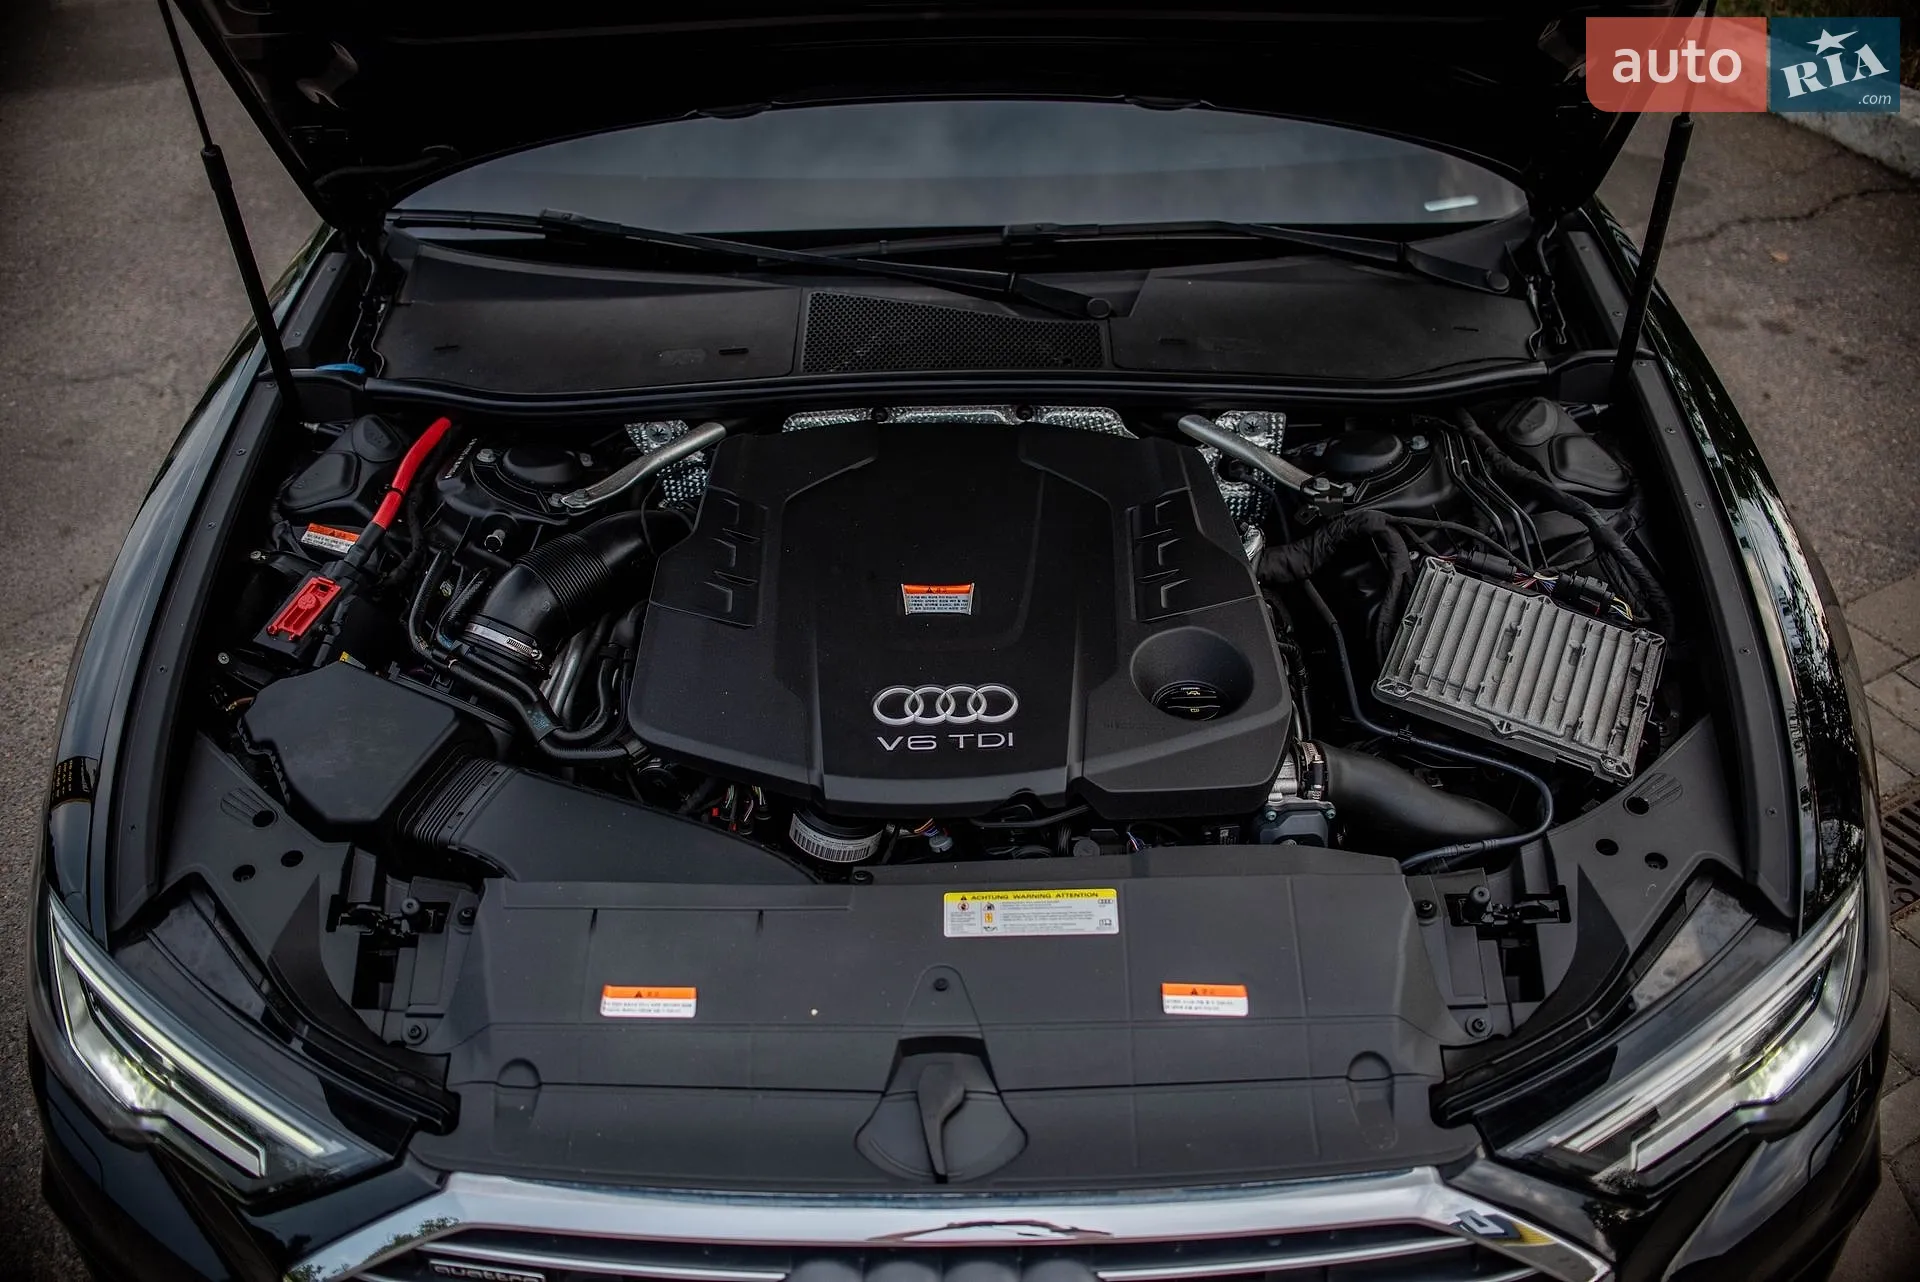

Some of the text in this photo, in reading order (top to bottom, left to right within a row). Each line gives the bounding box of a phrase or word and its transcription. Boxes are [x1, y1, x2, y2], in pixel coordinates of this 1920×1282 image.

[877, 732, 1013, 751] V6 TDI
[434, 1266, 540, 1282] quattro
